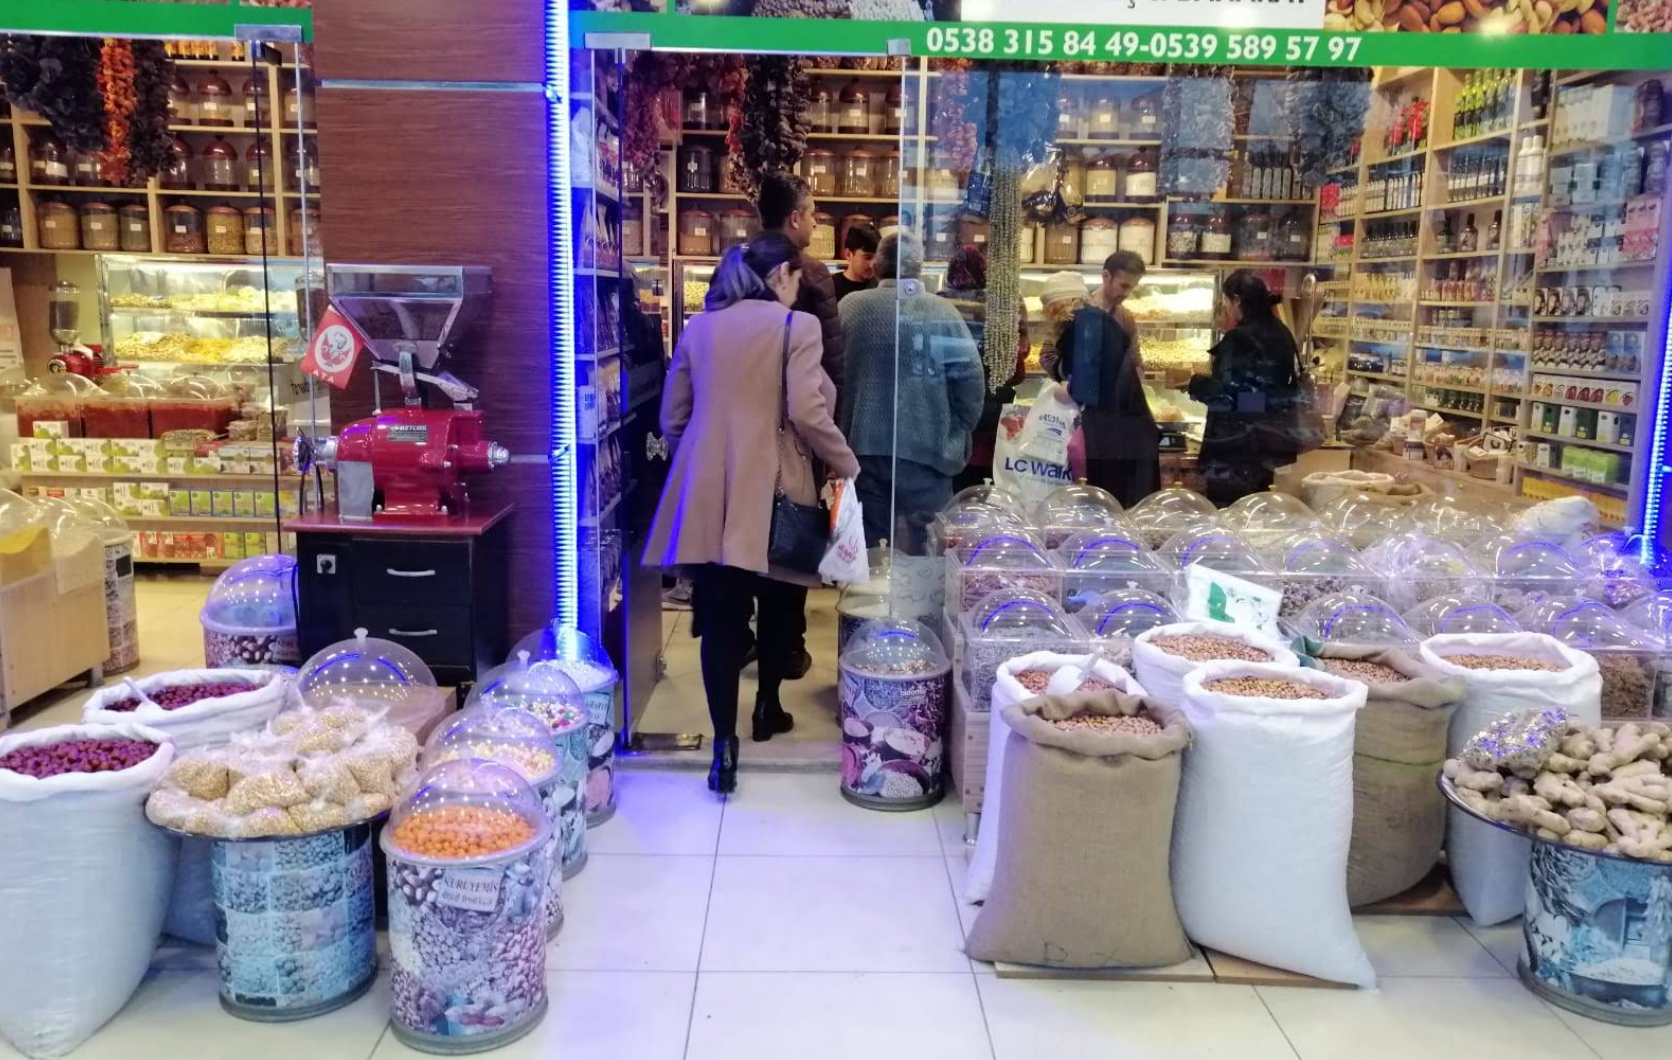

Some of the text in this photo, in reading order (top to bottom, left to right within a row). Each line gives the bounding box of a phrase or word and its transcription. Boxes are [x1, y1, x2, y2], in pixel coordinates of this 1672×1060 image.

[926, 27, 1362, 61] 0538 315 84 49-0539 589 57 97
[1004, 456, 1027, 473] LC
